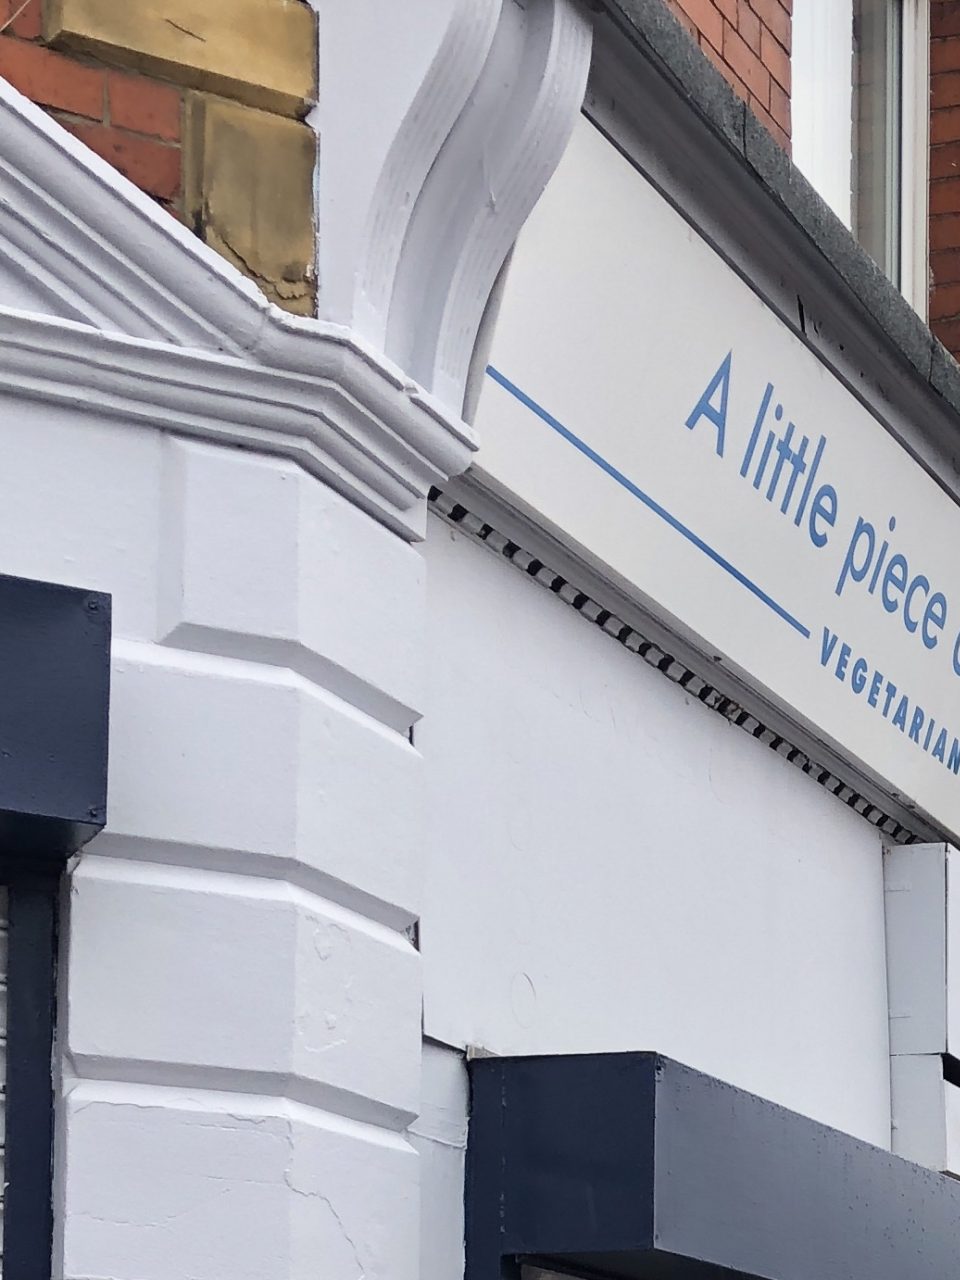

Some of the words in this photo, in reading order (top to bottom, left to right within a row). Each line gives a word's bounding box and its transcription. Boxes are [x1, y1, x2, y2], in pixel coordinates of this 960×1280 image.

[684, 349, 732, 459] A
[739, 382, 839, 548] little
[834, 515, 947, 650] piece
